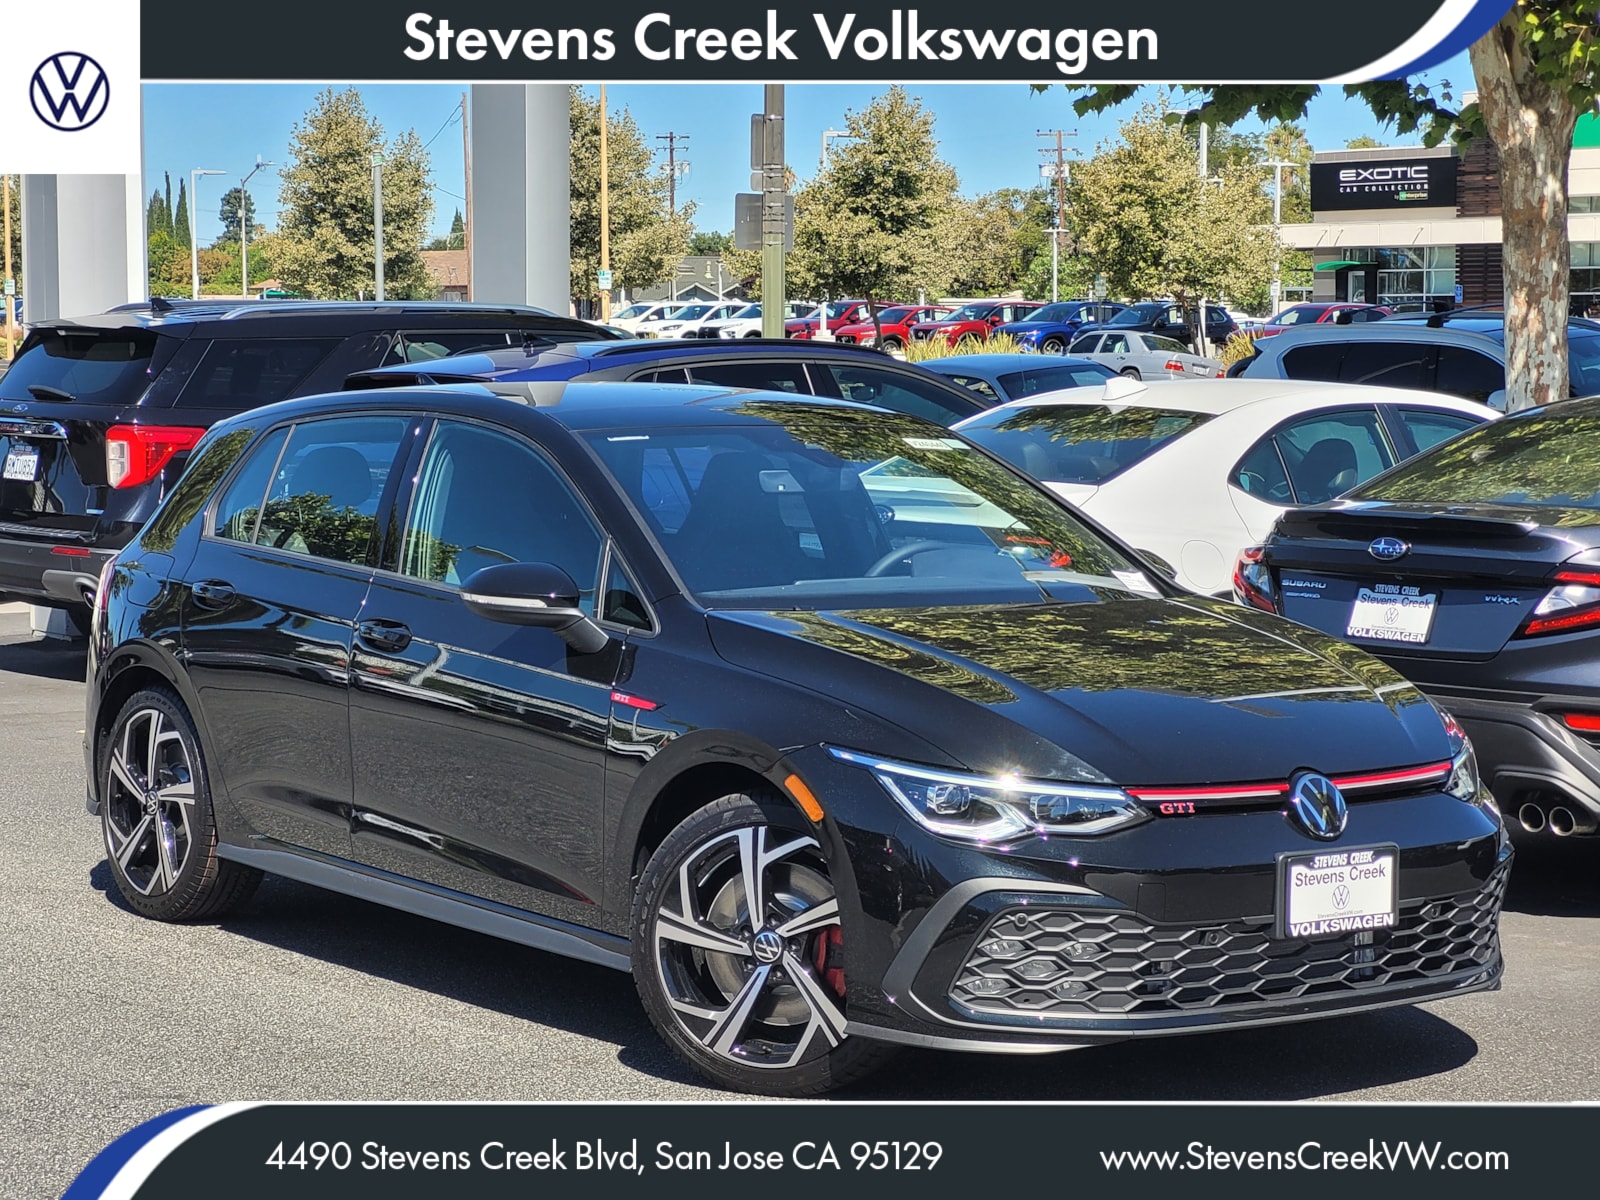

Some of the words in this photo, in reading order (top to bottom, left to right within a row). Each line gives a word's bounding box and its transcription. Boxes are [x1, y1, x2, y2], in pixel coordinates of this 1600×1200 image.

[1340, 166, 1428, 181] EXOTIC
[1365, 183, 1429, 192] COLLECTION
[1281, 579, 1327, 588] SUBARU
[1375, 584, 1400, 594] STEVENS
[1401, 586, 1420, 596] CREEK
[1360, 593, 1397, 606] Stevens
[1401, 597, 1431, 609] Creek
[1485, 595, 1520, 605] WRX
[1347, 627, 1425, 643] VOLKSWAGEN
[1160, 802, 1195, 814] GTI
[1314, 853, 1347, 868] STEVENS
[1350, 851, 1374, 864] CREEK
[1295, 872, 1345, 887] Stevens
[1349, 864, 1386, 880] Creek
[1290, 913, 1394, 937] VOLKSWAGEN
